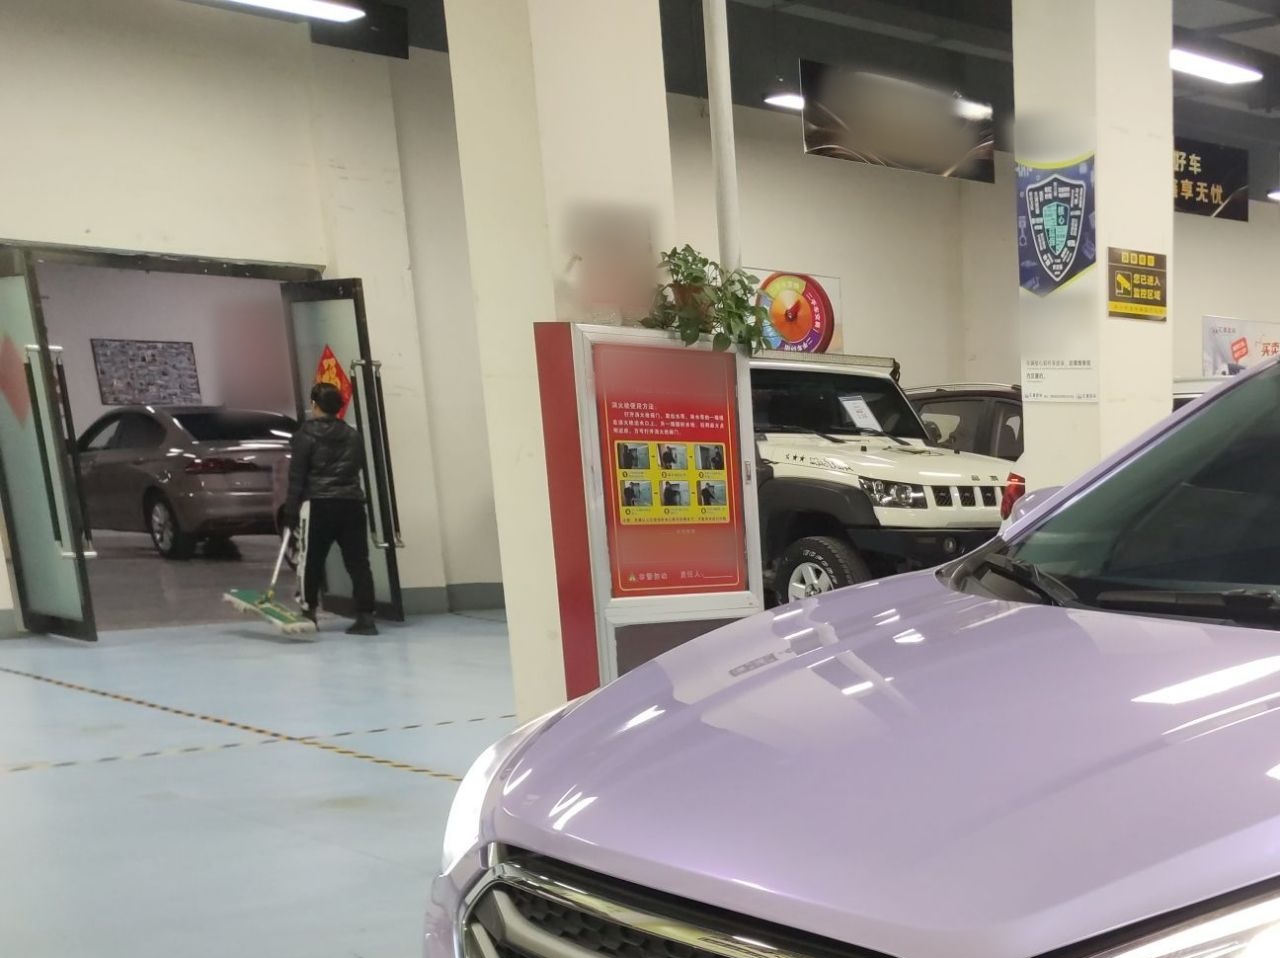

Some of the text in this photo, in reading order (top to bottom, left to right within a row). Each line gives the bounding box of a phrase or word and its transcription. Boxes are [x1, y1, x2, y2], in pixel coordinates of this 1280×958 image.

[1174, 179, 1224, 205] 享无忧
[1133, 273, 1161, 287] 您已进入
